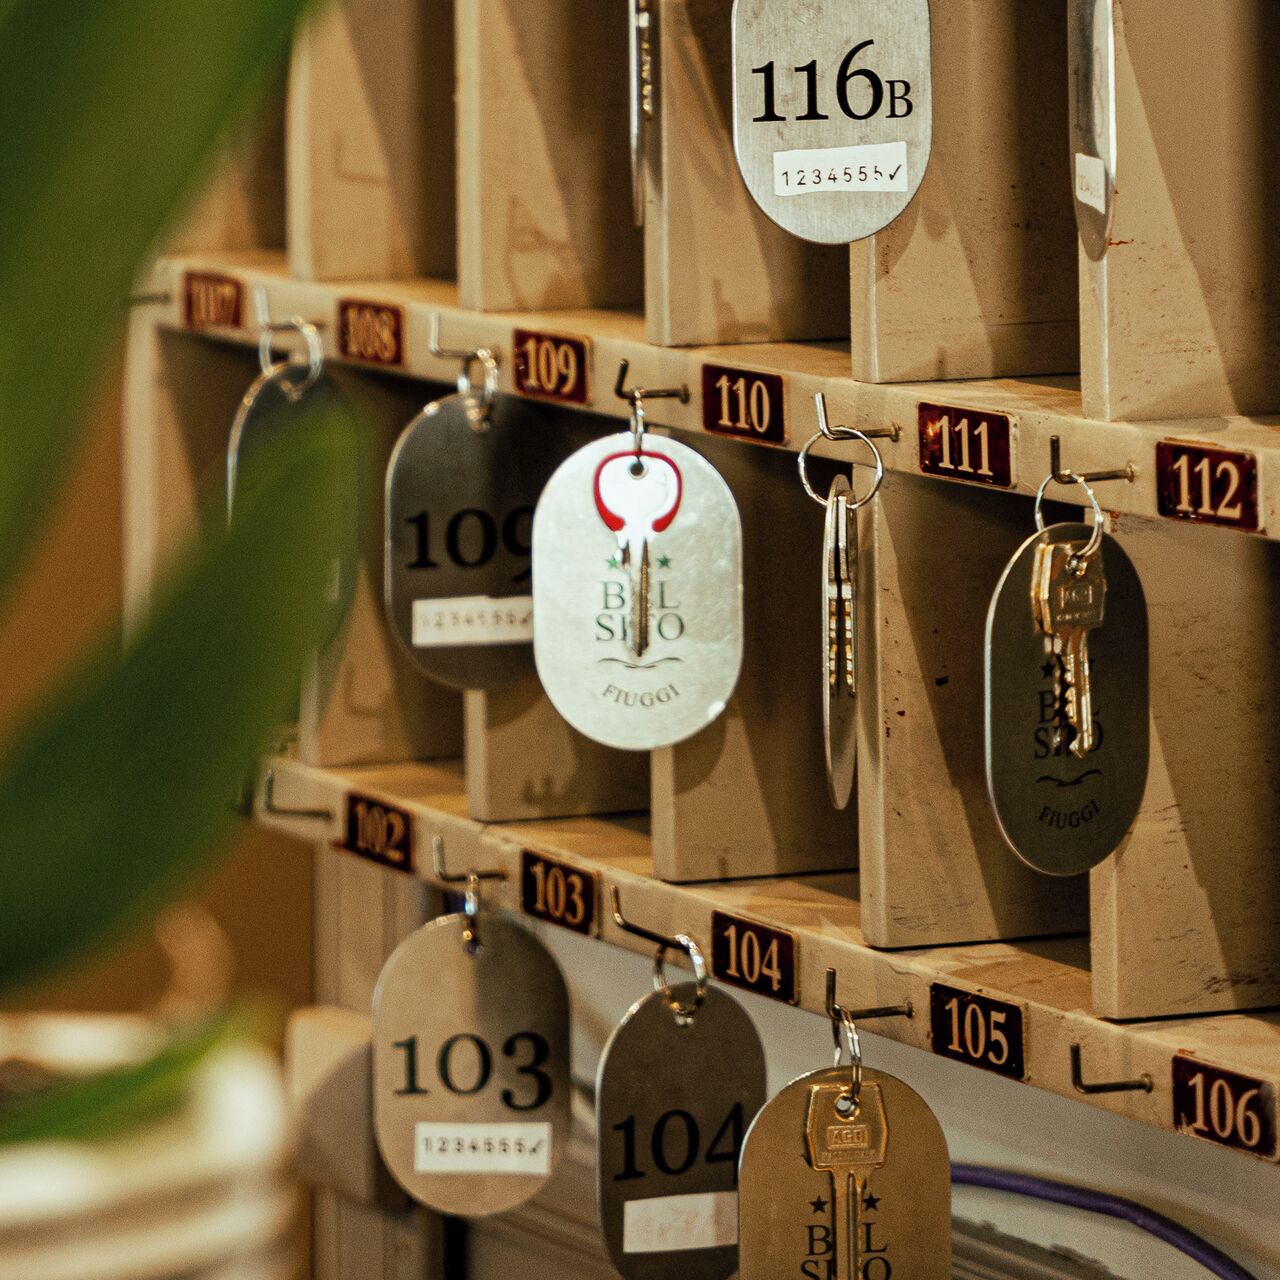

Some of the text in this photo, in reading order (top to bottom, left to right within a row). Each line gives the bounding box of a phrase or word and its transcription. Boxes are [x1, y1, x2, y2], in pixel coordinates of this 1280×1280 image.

[751, 38, 914, 123] 116B
[521, 336, 577, 395] 109
[716, 375, 769, 433] 110
[935, 415, 994, 476] 111
[1172, 454, 1241, 519] 112
[404, 505, 533, 584] 109
[602, 579, 680, 610] BL
[595, 612, 685, 641] SIO
[602, 684, 680, 707] FIUGGI
[355, 802, 404, 860] 102
[1038, 799, 1101, 829] FIUGGI
[531, 863, 585, 924] 103
[723, 924, 782, 992] 104
[945, 997, 1009, 1066] 105
[392, 1031, 553, 1112] 103
[1188, 1072, 1261, 1148] 106
[614, 1103, 744, 1184] 104
[806, 1223, 888, 1256] BL
